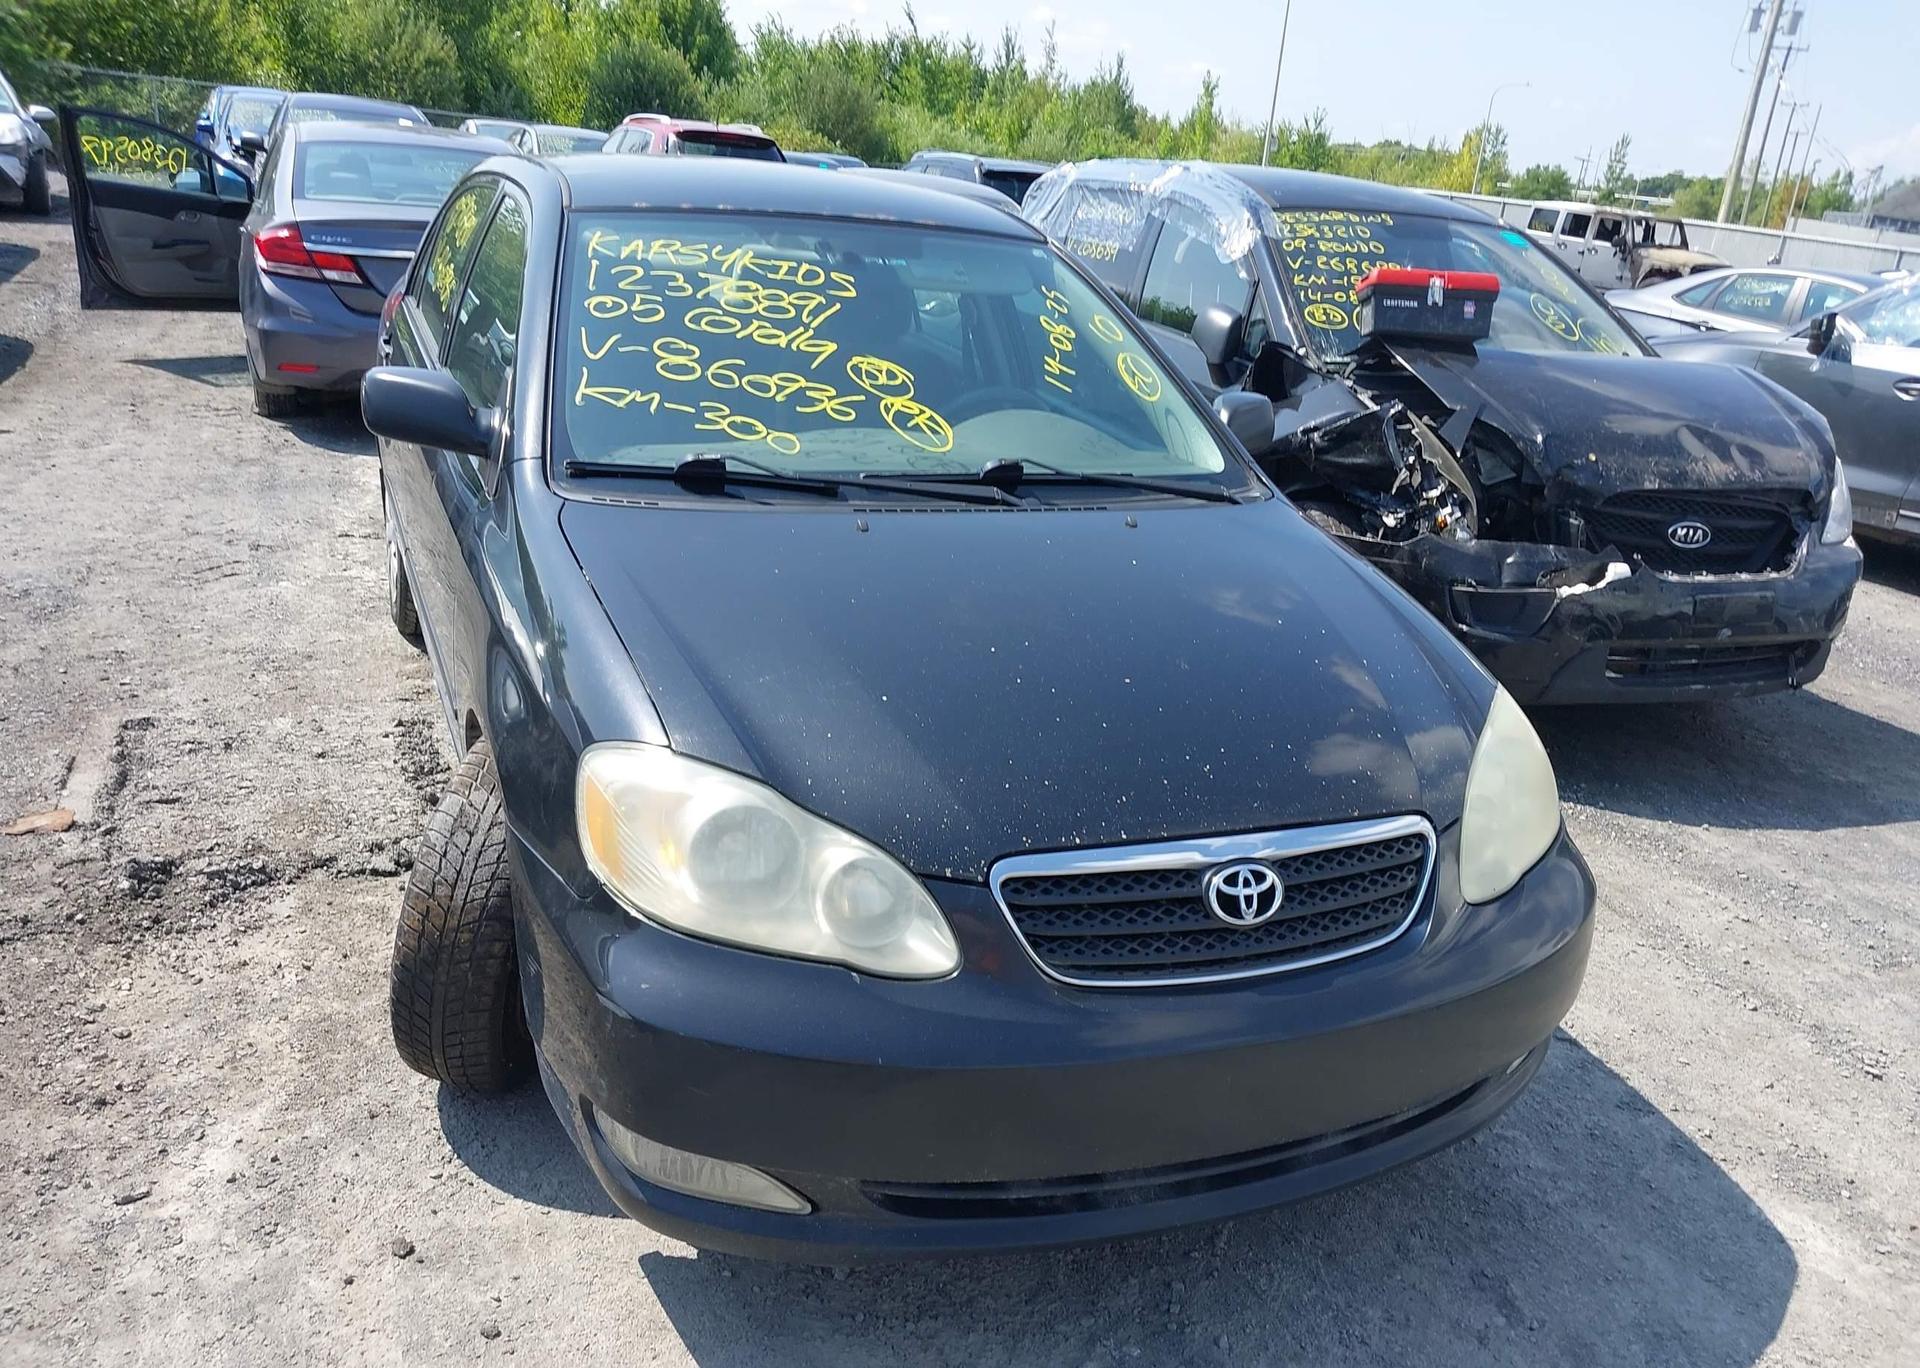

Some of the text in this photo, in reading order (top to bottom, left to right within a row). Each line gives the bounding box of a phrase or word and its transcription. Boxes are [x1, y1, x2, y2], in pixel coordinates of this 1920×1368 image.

[588, 259, 841, 328] 12378891
[1383, 298, 1418, 308] CRAFTSMAN
[584, 294, 666, 323] 05
[580, 327, 866, 421] V-860936
[1673, 525, 1705, 545] KIA
